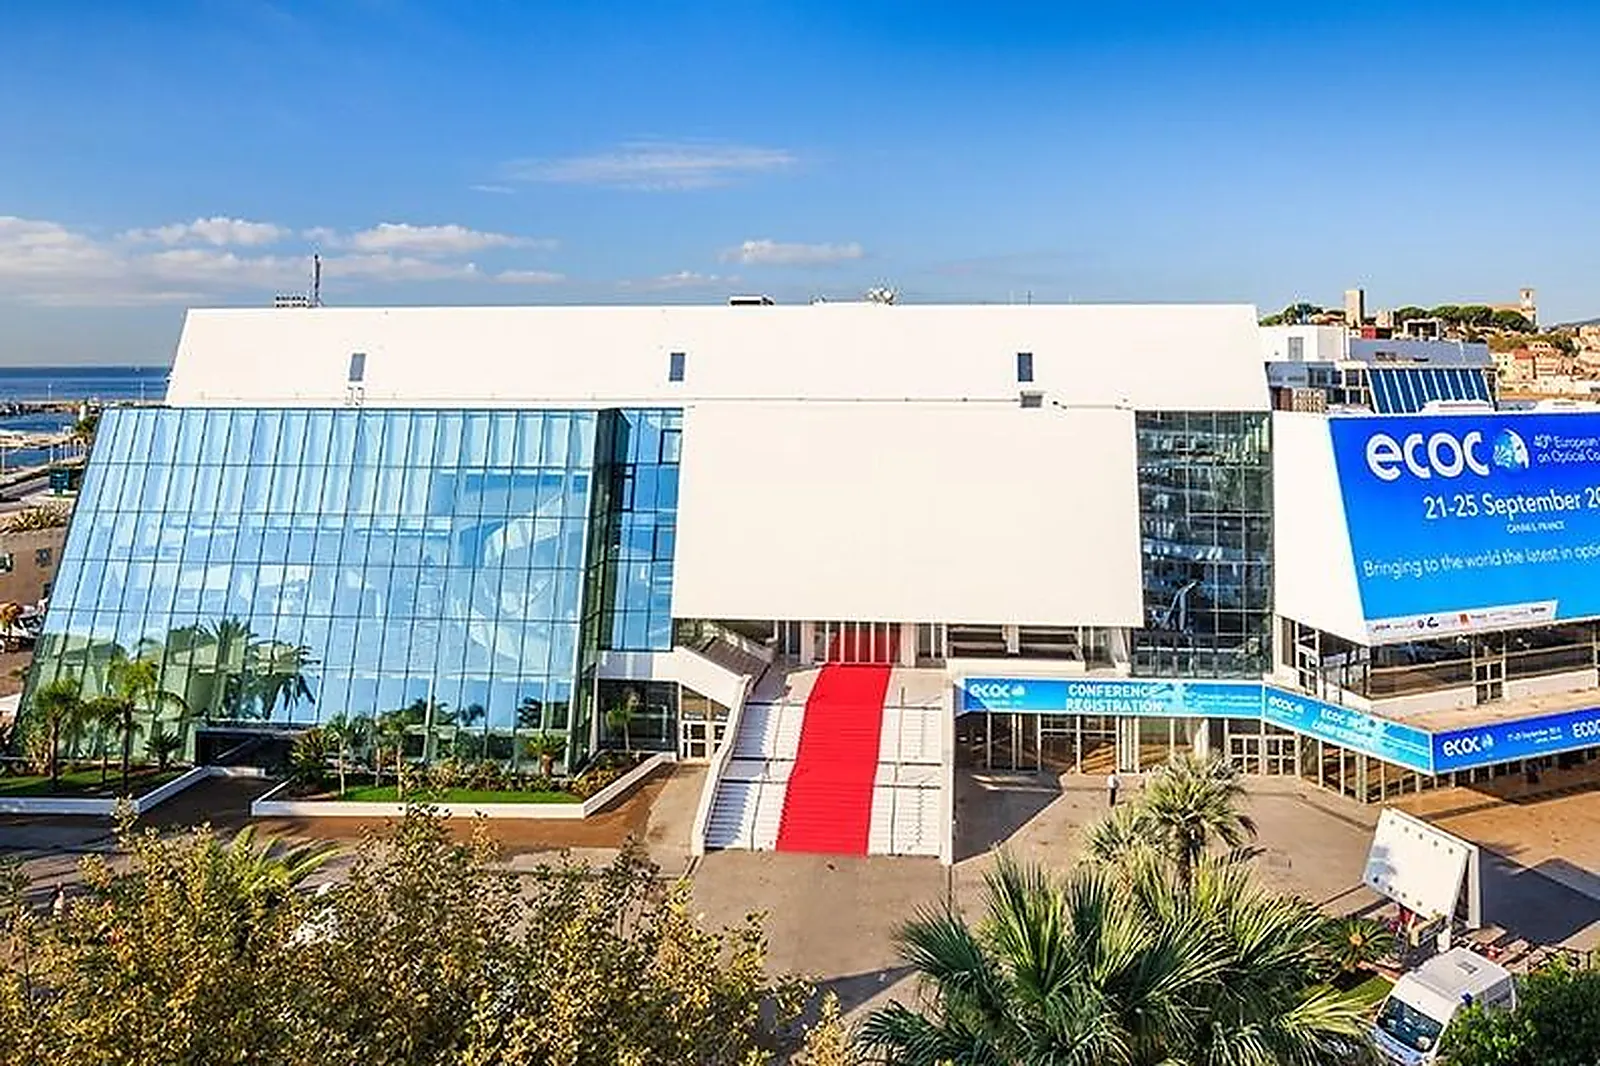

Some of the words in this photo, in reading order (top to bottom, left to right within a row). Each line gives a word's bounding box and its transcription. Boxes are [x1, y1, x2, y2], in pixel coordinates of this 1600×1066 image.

[1366, 431, 1490, 481] ecoc
[1423, 494, 1478, 518] 21-25
[1482, 487, 1580, 520] September
[1363, 558, 1423, 580] Bringing
[1423, 558, 1439, 572] to
[1440, 553, 1463, 571] the
[1464, 550, 1501, 567] world
[1502, 548, 1523, 564] the
[969, 683, 1011, 698] ecoc
[1068, 683, 1159, 698] CONFERENCE
[1066, 698, 1163, 712] REGISTRATION
[1443, 735, 1482, 757] ecoc
